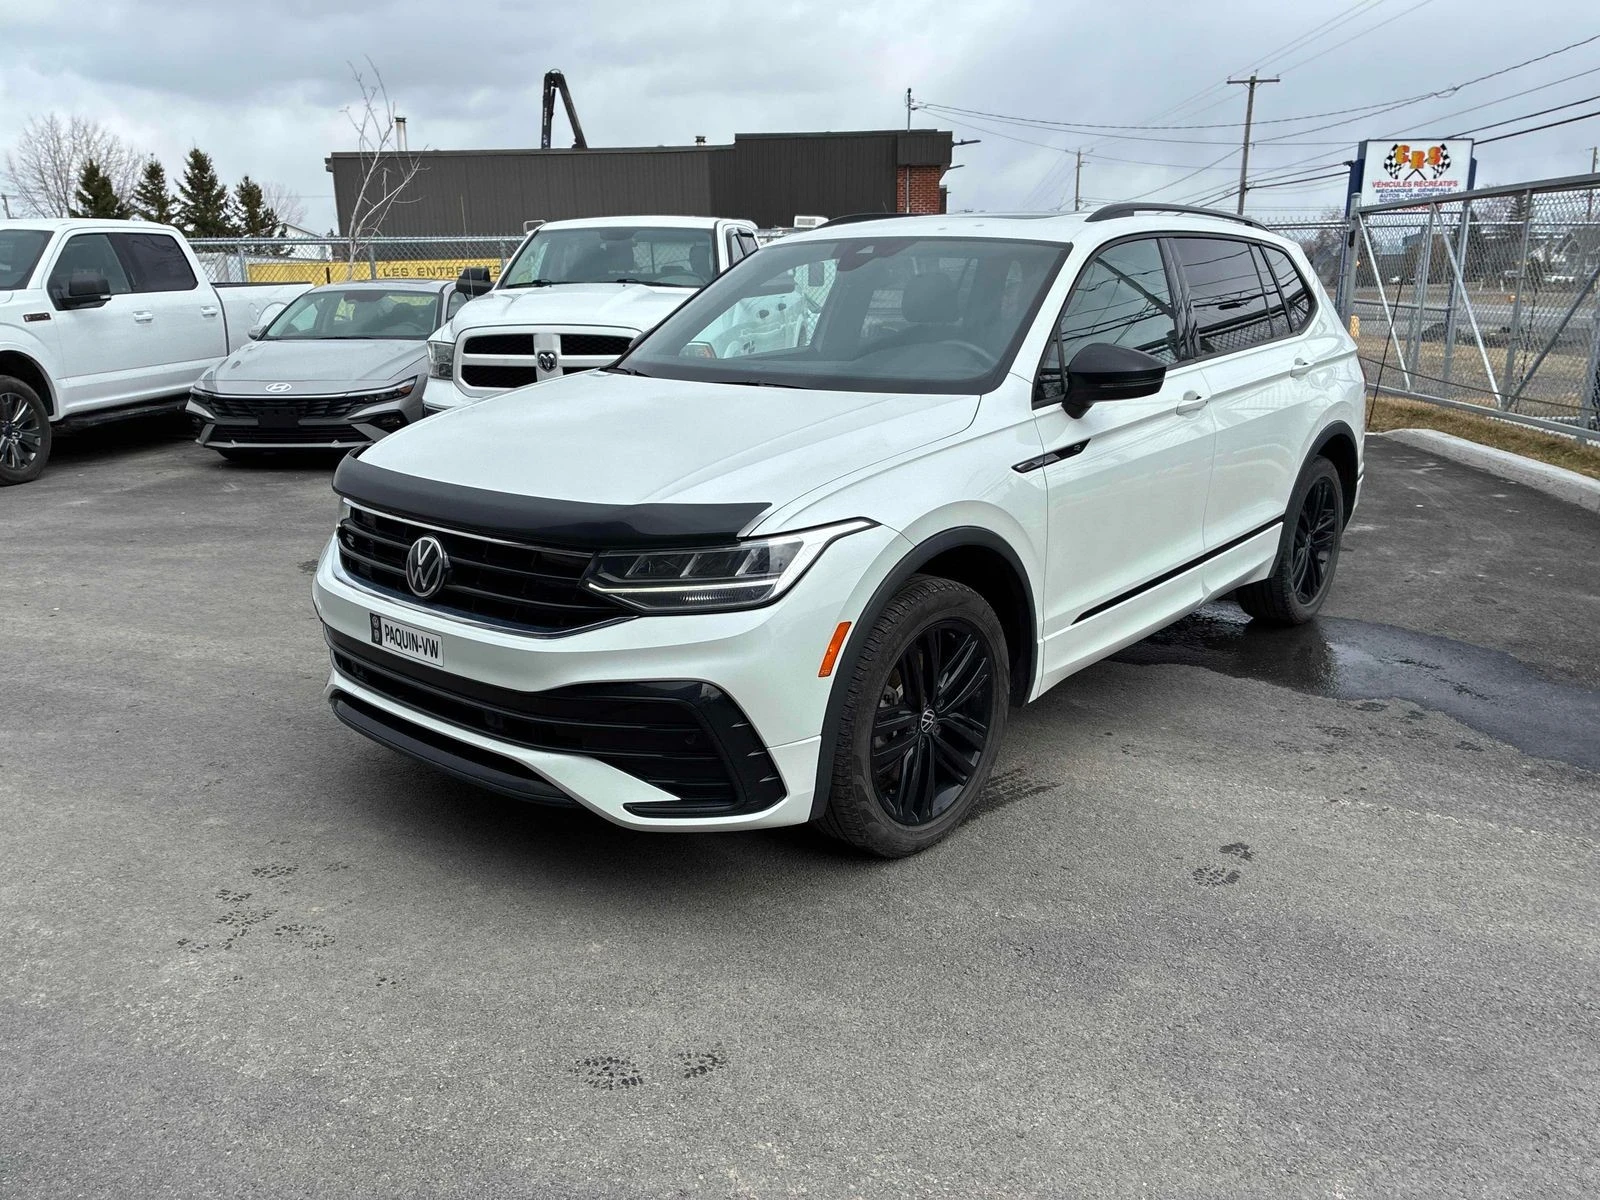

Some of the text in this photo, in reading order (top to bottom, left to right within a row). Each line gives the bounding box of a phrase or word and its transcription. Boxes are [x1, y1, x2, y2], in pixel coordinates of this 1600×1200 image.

[1372, 180, 1412, 188] VÉHICULES
[383, 267, 409, 277] LES
[384, 624, 439, 659] PAQUIN-VW
